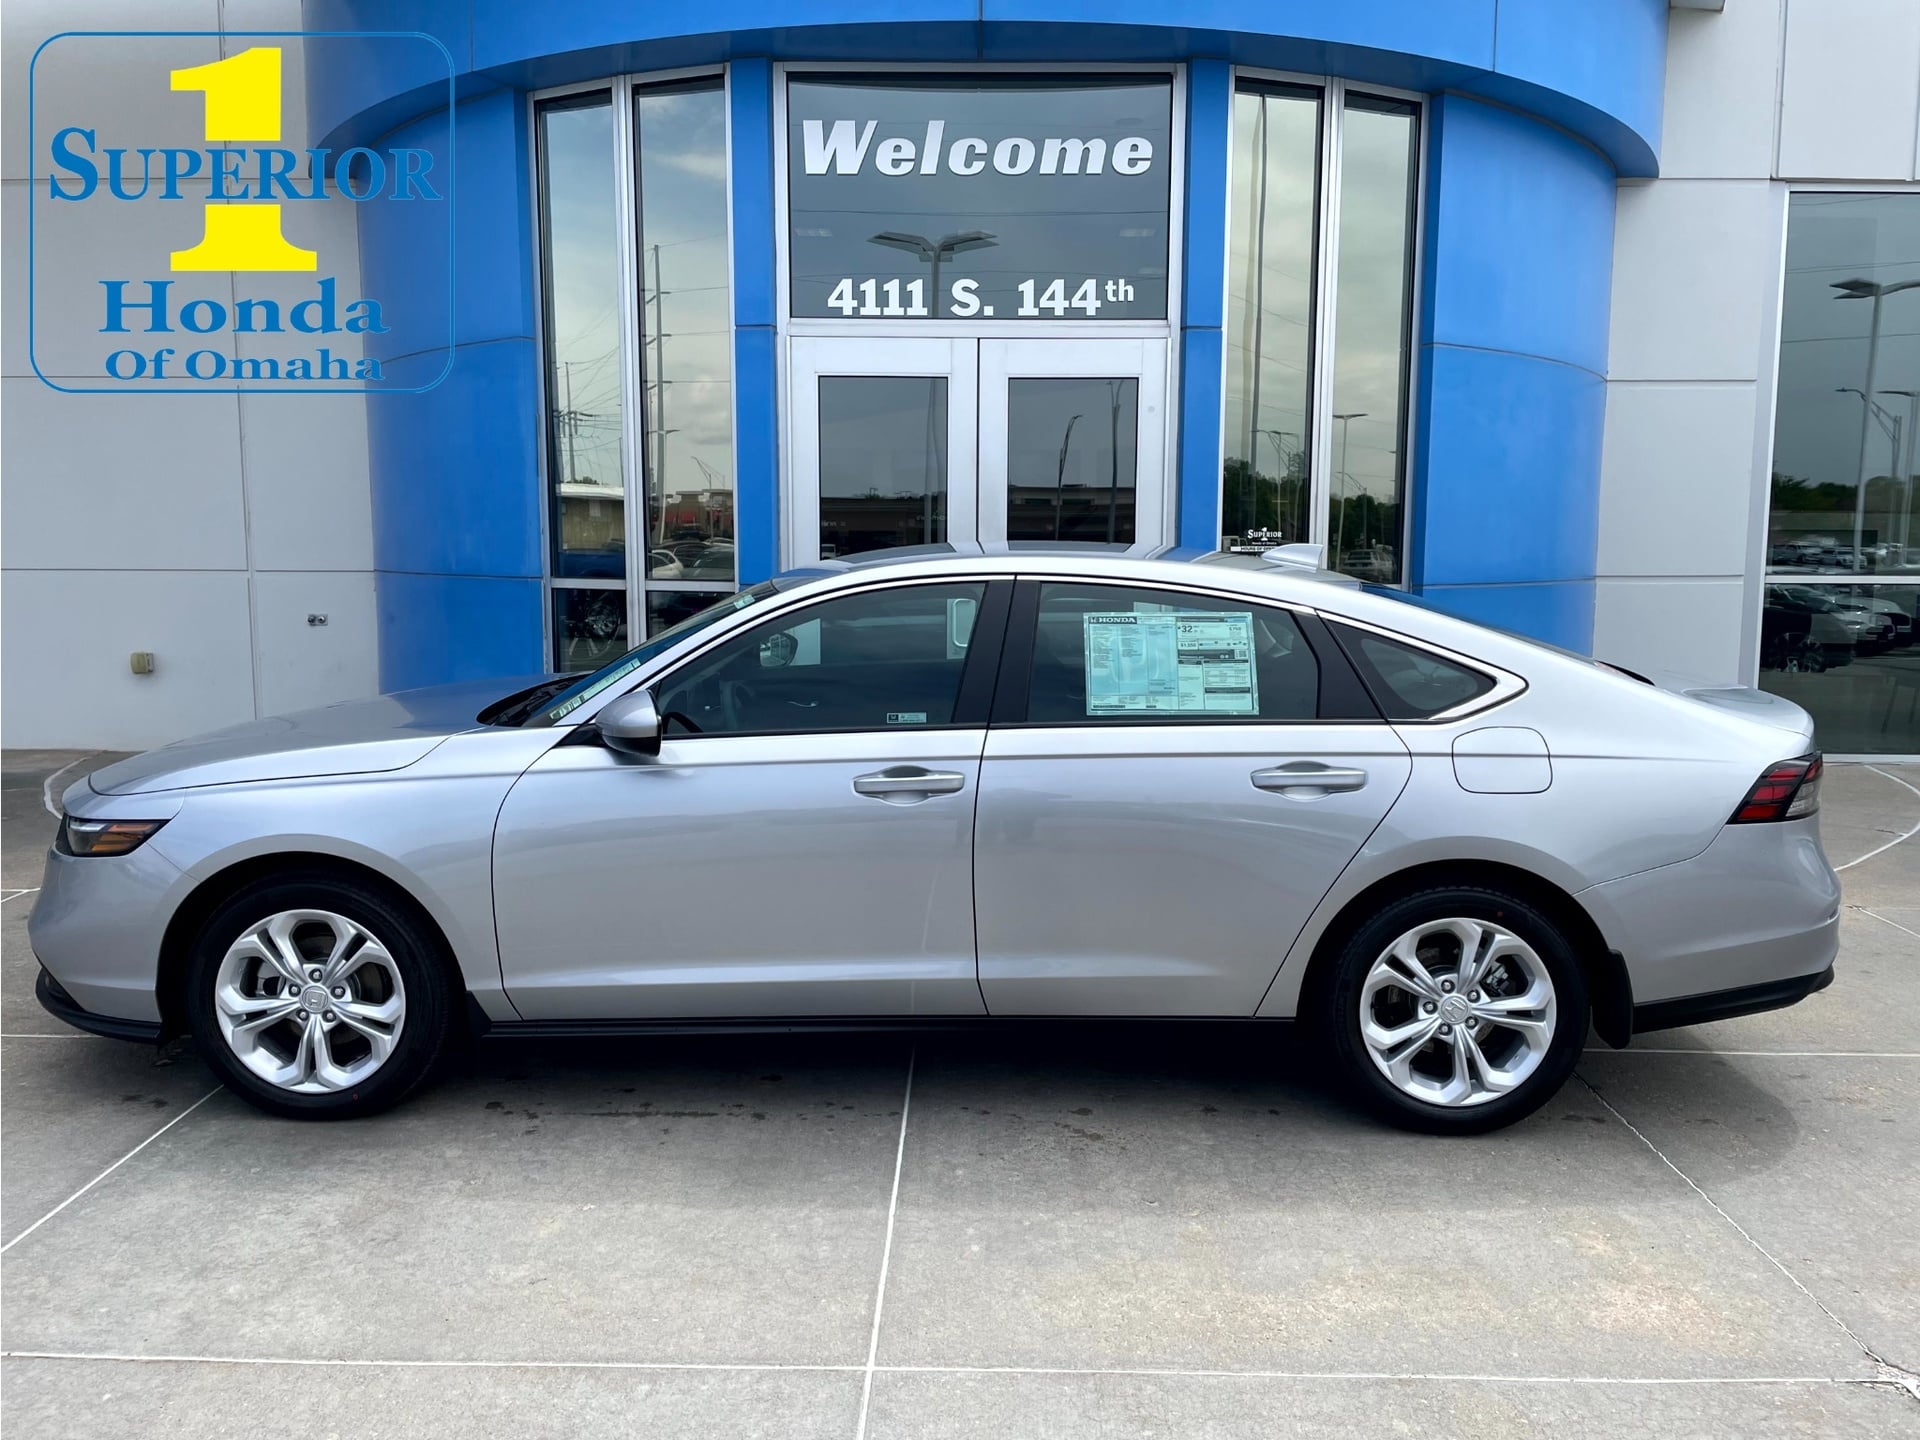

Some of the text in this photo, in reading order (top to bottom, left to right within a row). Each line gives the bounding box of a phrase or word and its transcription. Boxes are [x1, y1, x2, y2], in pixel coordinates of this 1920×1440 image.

[802, 119, 1154, 176] Welcome
[827, 278, 1135, 317] 4111 S. 144th
[1247, 529, 1282, 539] SUPERIOR
[1181, 625, 1193, 633] 32
